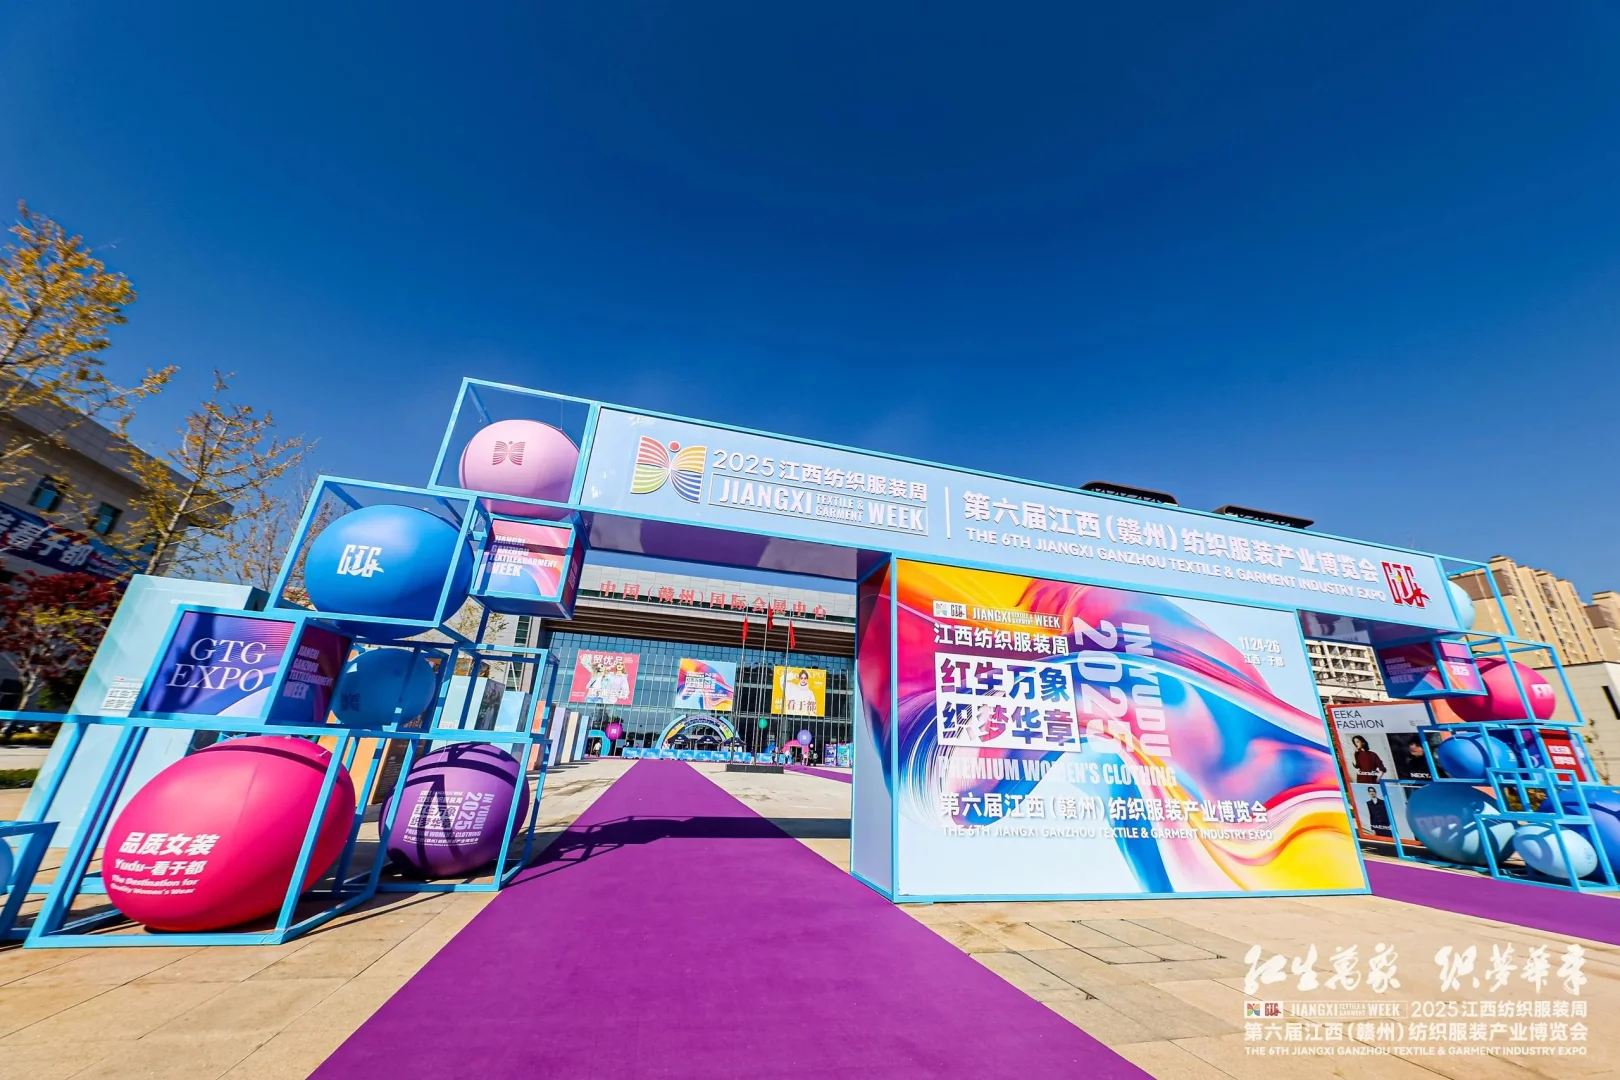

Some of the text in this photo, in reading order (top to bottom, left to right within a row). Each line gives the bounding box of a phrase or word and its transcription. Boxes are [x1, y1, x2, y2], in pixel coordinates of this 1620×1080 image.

[719, 478, 924, 531] JIANGXI TEXTILE & GARMENT WEEK
[486, 561, 523, 577] WEEK
[966, 527, 1387, 602] THE 6TH JIANGXI GANZHOU TEXTILE & GARMENT INDUSTRY EXPO
[972, 607, 1012, 623] JIANGXI
[1035, 614, 1061, 629] WEEK
[190, 637, 267, 665] GTG
[933, 622, 1069, 656] 江西纺织服装周
[1240, 636, 1281, 654] 11.24-26
[165, 663, 264, 692] EXPO
[283, 680, 310, 700] WEEK
[940, 657, 1070, 702] 红生万象
[1072, 616, 1135, 754] 2025
[1122, 622, 1172, 757] IN YUDU
[942, 701, 1076, 746] 织梦华章
[1333, 710, 1361, 719] EEKA
[1336, 720, 1384, 729] FASHION
[939, 756, 1020, 781] PREMIUM
[1102, 763, 1178, 787] CLOTHING
[454, 791, 483, 831] 2025
[118, 831, 220, 856] 品质女装
[943, 824, 1273, 840] THE 6TH JIANGXI GANZHOU TEXTILE & GARMENT INDUSTRY EXPO
[181, 878, 200, 887] for
